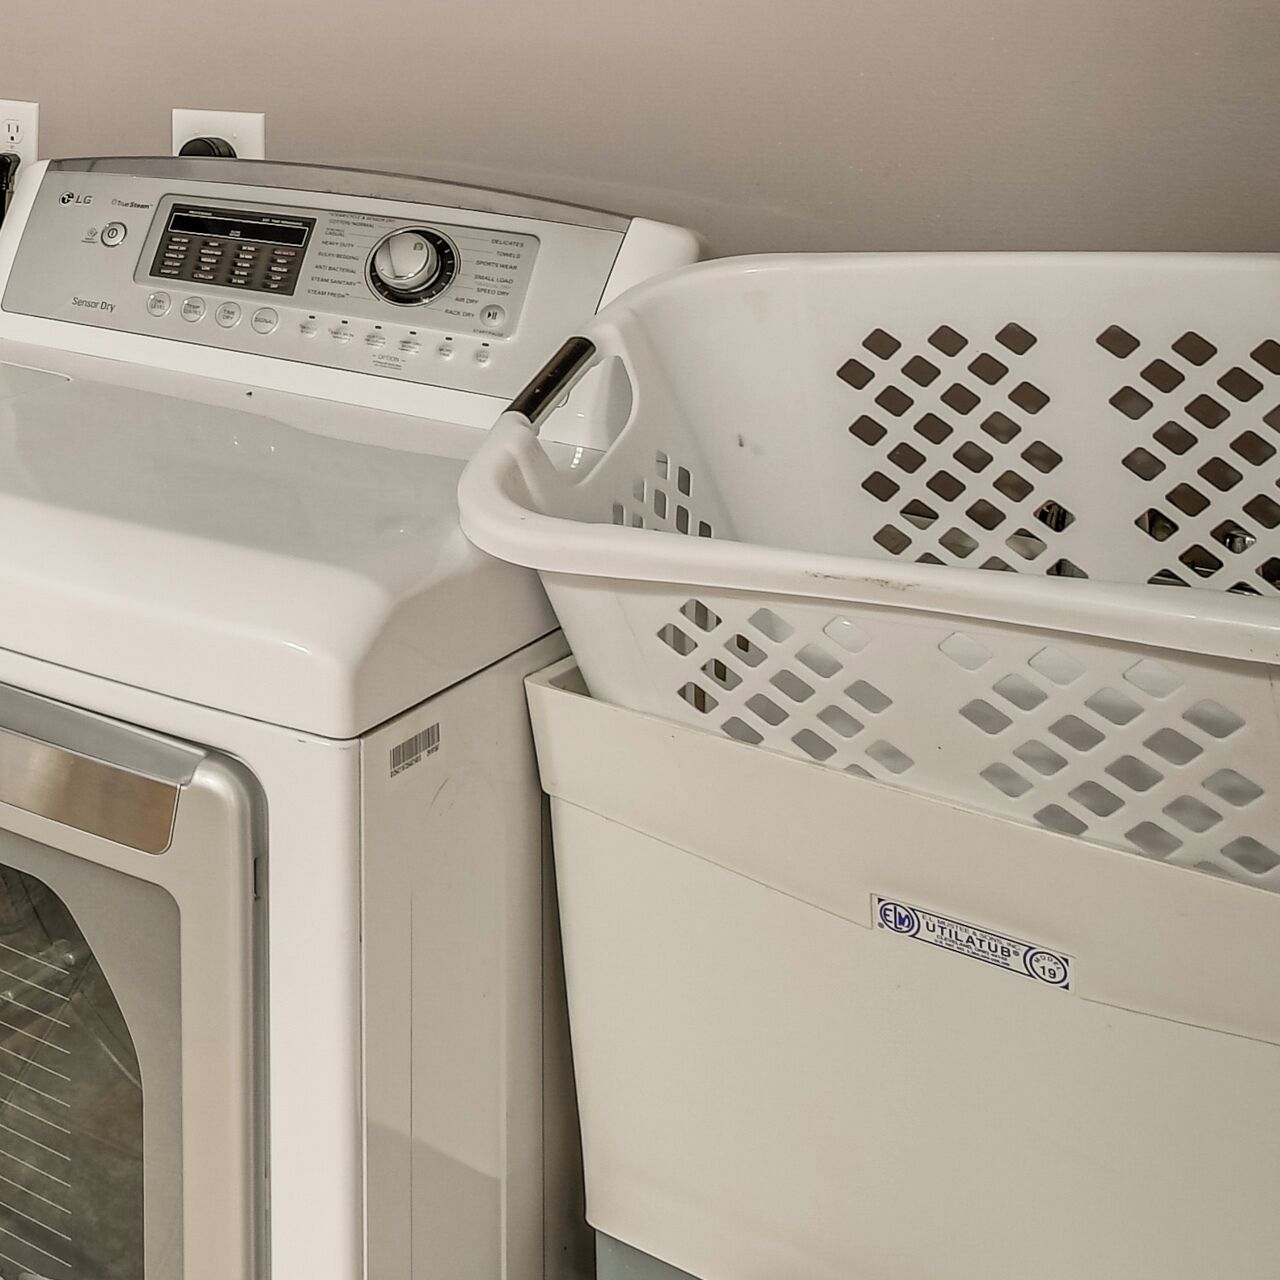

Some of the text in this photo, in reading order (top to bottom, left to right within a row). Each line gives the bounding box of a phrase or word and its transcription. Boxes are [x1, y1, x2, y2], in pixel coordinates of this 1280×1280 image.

[75, 194, 93, 205] LG
[72, 296, 116, 313] Sensor Dry
[1033, 955, 1063, 971] MODEL
[1039, 965, 1057, 979] 19
